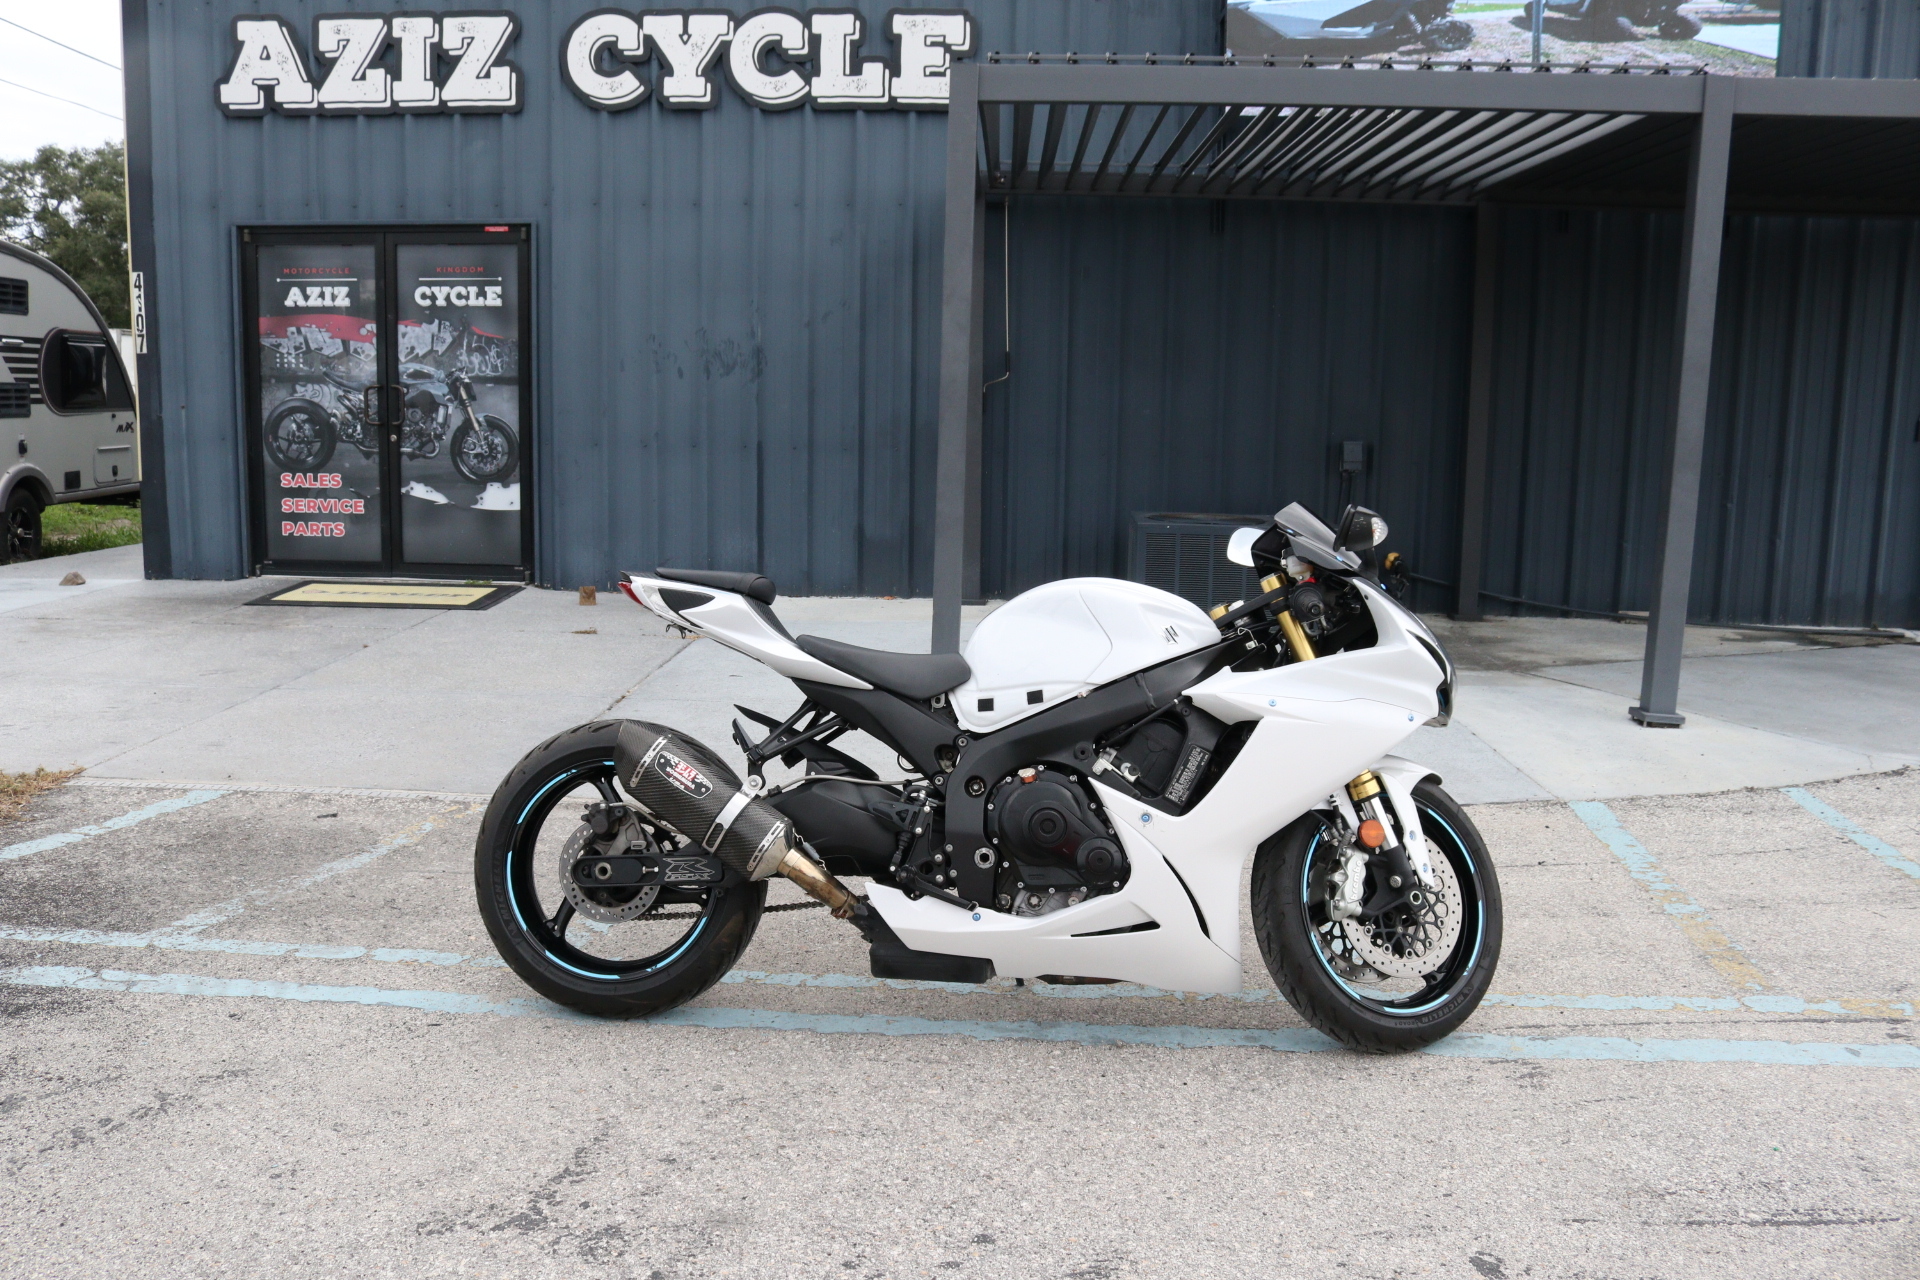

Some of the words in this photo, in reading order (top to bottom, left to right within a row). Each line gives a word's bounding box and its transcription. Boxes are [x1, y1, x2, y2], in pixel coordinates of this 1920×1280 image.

[219, 16, 517, 111] AZIZ
[566, 13, 971, 106] CYCLE
[284, 286, 350, 307] AZIZ
[414, 285, 502, 307] CYCLE
[280, 472, 342, 489] SALES
[281, 496, 365, 514] SERVICE
[281, 521, 345, 537] PARTS
[1350, 860, 1362, 900] brembo
[1421, 994, 1465, 1023] MICHELIN
